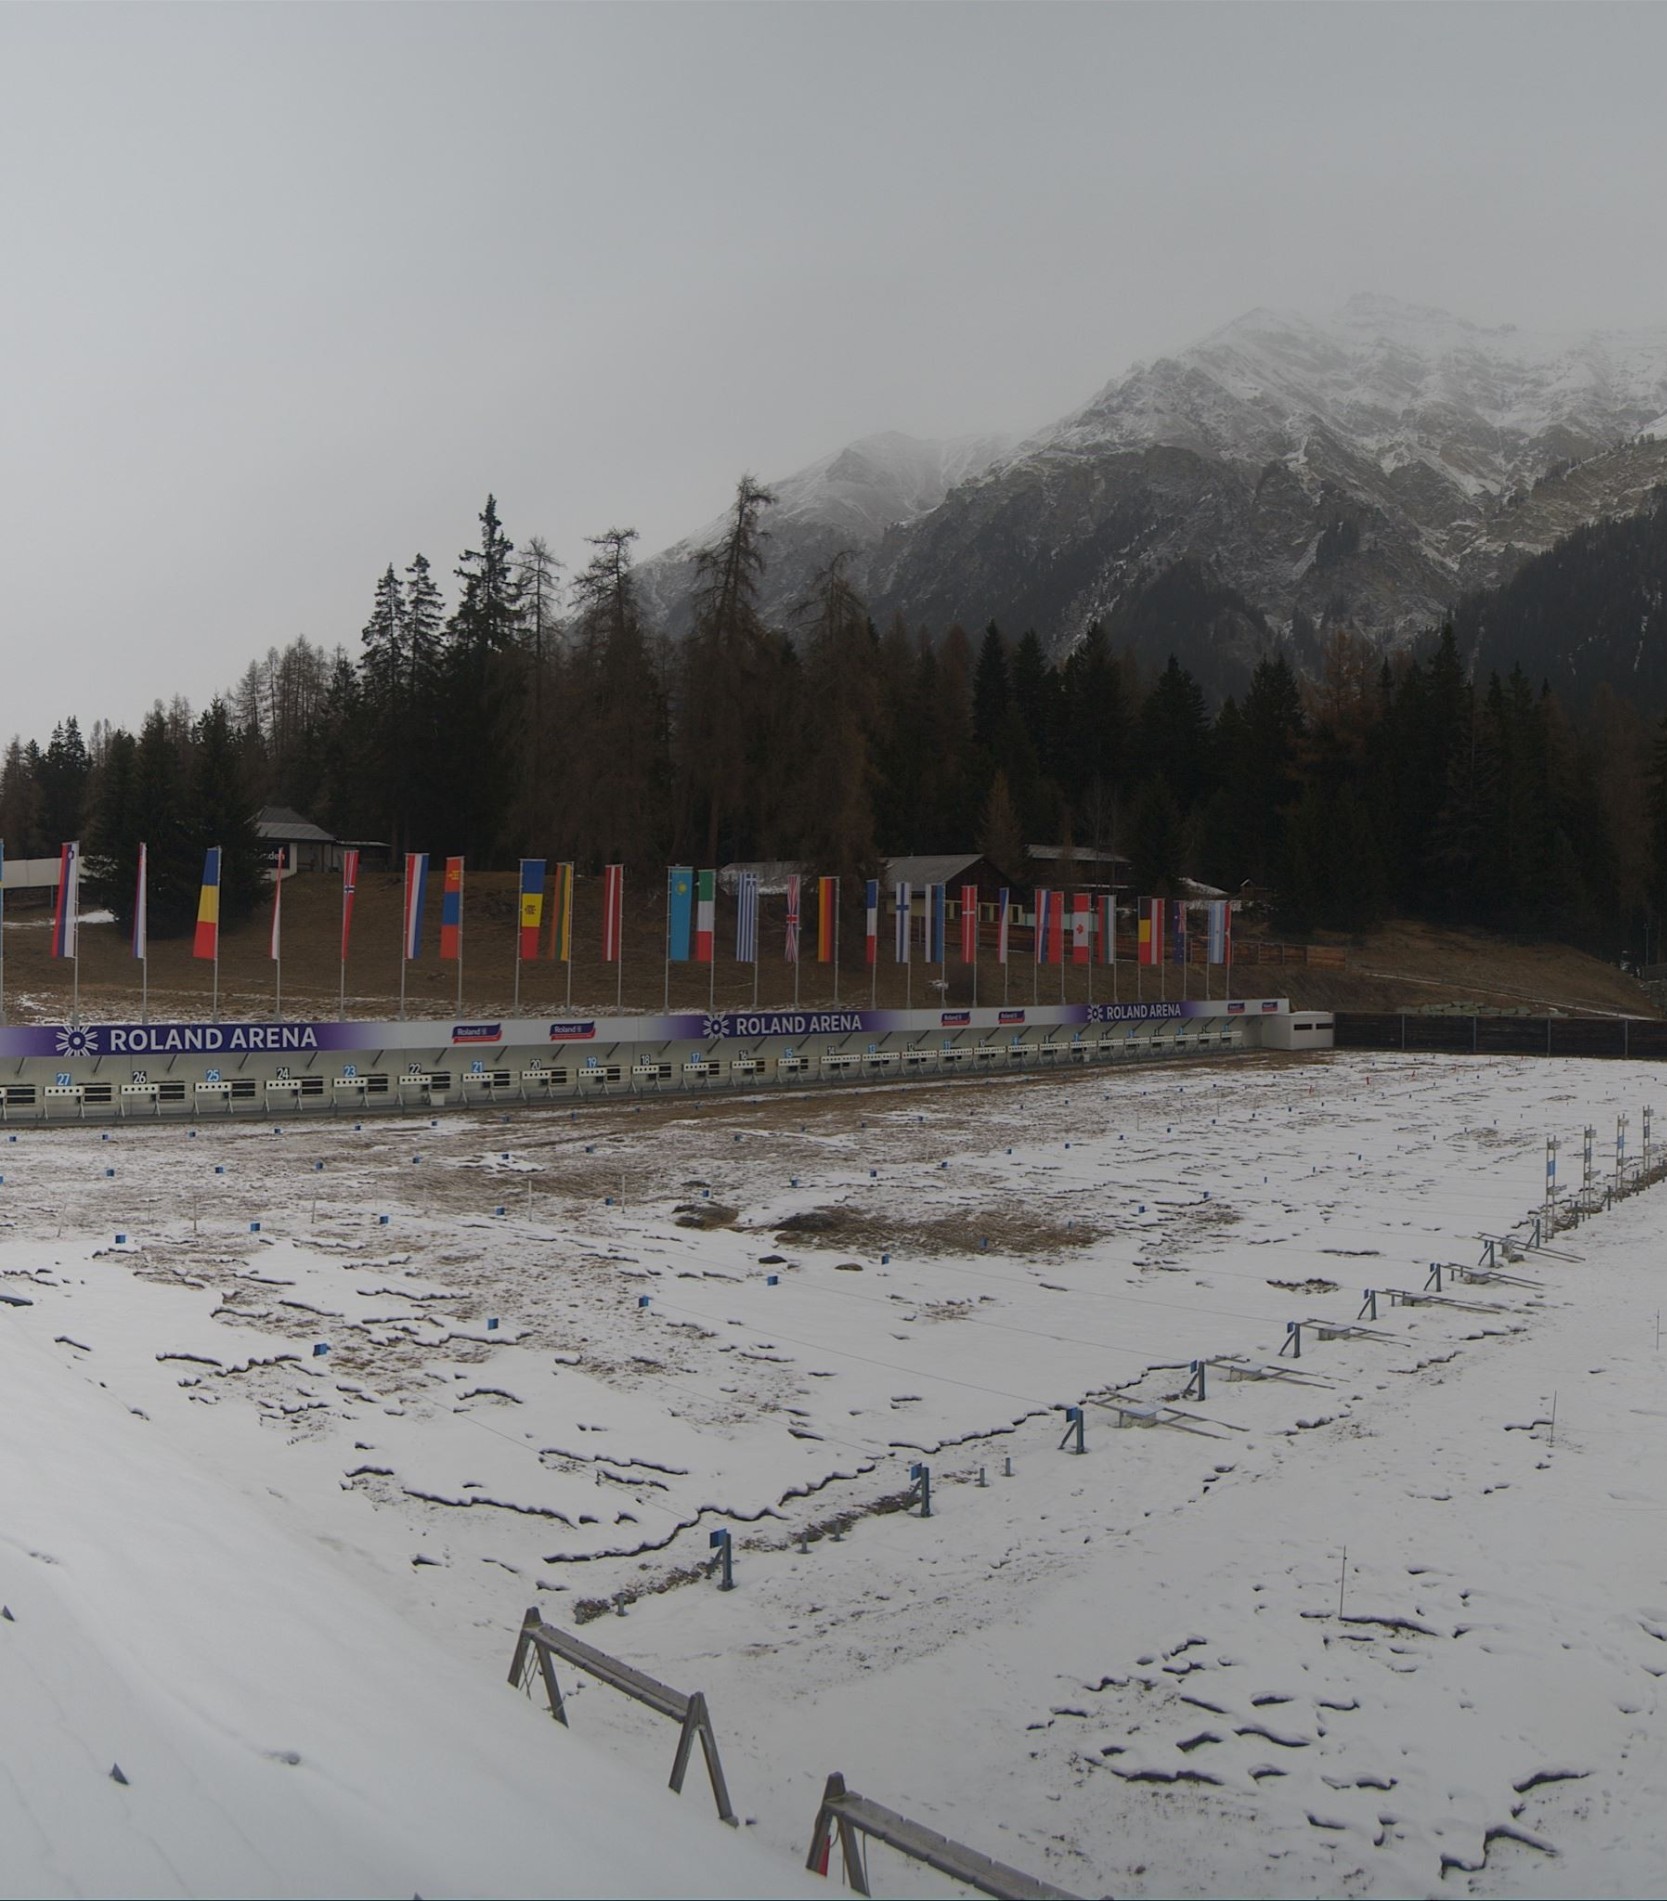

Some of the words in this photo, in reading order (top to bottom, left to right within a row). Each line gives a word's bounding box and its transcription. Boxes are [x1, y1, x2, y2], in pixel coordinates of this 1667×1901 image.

[1106, 1005, 1147, 1020] ROLAND
[1150, 1003, 1181, 1017] ARENA
[554, 1025, 575, 1033] Roland
[737, 1017, 806, 1035] ROLAND
[809, 1015, 862, 1032] ARENA
[457, 1026, 480, 1035] Roland
[110, 1028, 223, 1052] ROLAND
[230, 1027, 317, 1049] ARENA
[692, 1053, 700, 1062] 17
[740, 1051, 748, 1059] 16
[785, 1049, 793, 1058] 15
[531, 1060, 541, 1070] 20
[587, 1057, 596, 1067] 19
[641, 1055, 650, 1065] 18
[345, 1066, 356, 1076] 23
[410, 1064, 420, 1074] 22
[473, 1062, 483, 1072] 21
[133, 1072, 146, 1083] 26
[207, 1070, 219, 1081] 25
[277, 1068, 289, 1079] 24
[57, 1073, 70, 1086] 27
